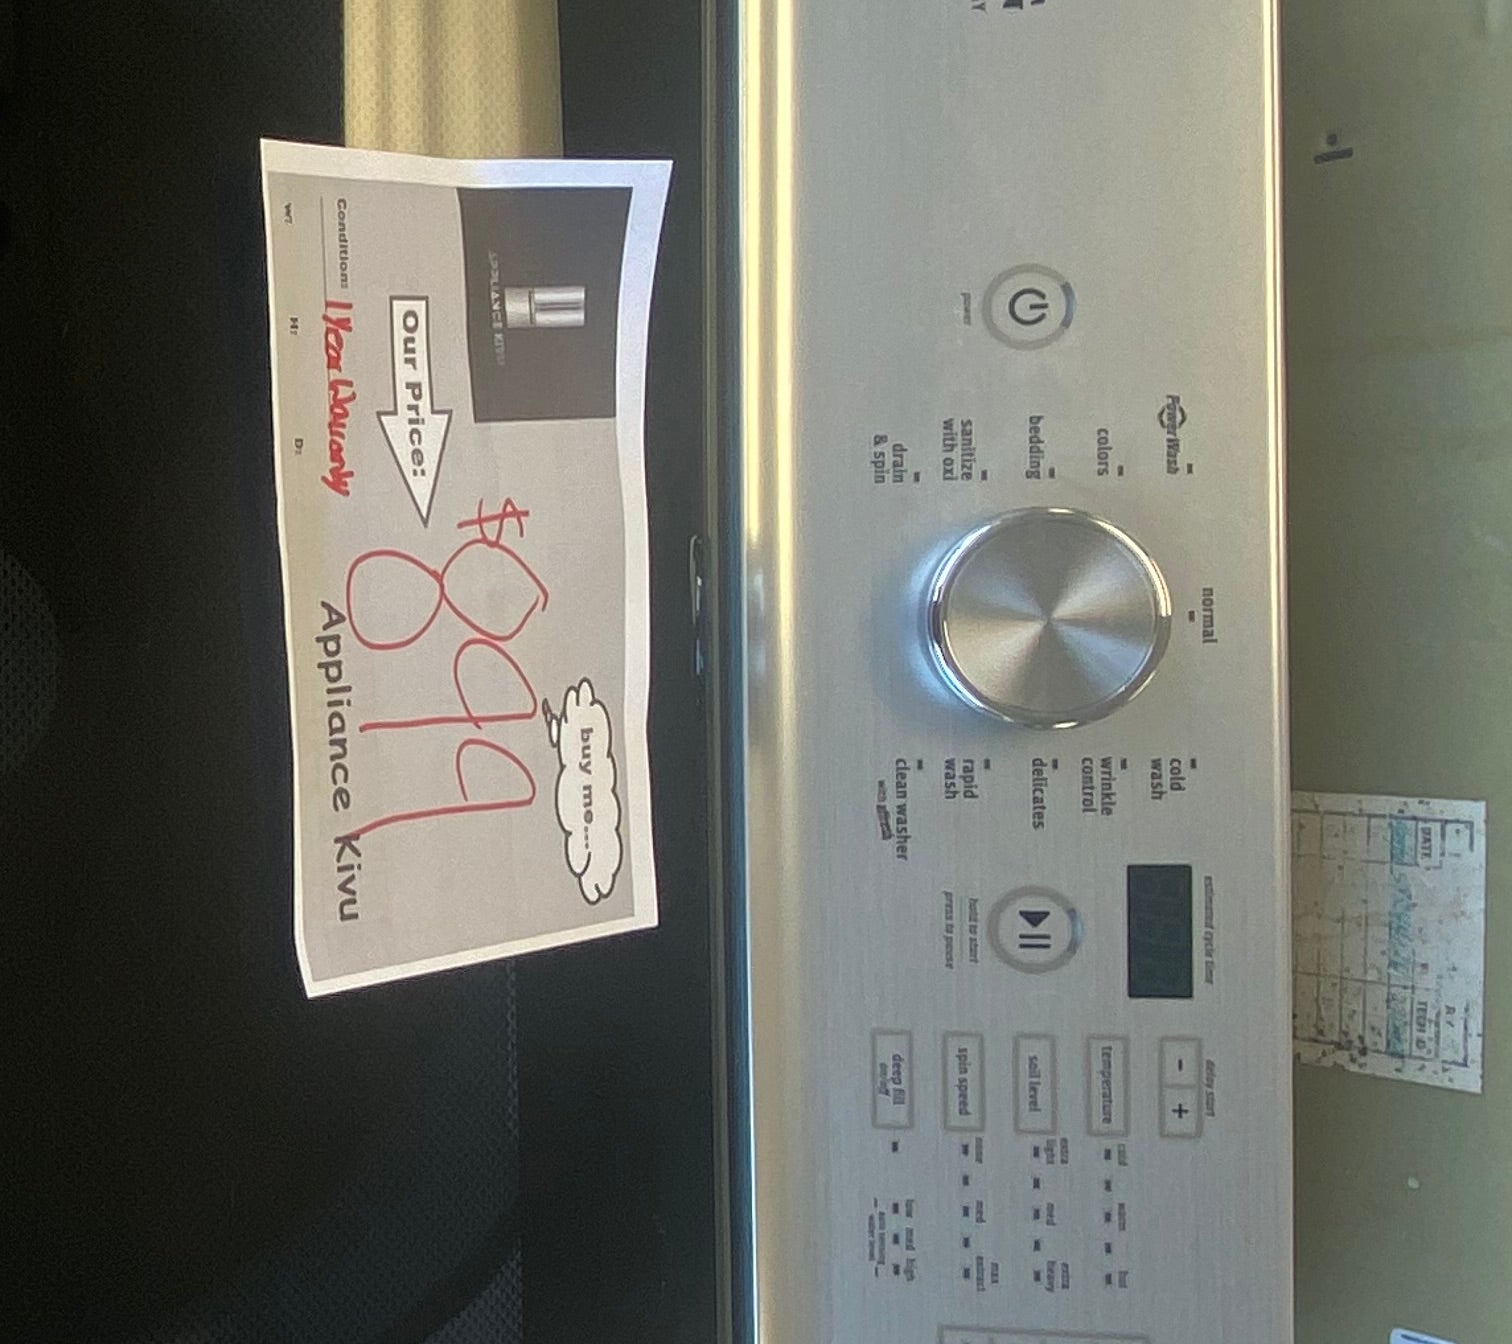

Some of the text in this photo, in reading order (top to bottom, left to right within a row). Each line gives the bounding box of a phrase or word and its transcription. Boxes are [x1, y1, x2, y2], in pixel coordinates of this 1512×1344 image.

[336, 197, 349, 290] Condition:
[961, 292, 972, 326] power
[321, 312, 355, 373] Year
[401, 309, 428, 478] Our Price:
[870, 433, 890, 485] & spin
[891, 442, 909, 484] drain
[941, 417, 958, 482] with oxi
[960, 418, 977, 482] sanitize
[1025, 414, 1045, 480] bedding
[1096, 427, 1112, 477] colors
[1162, 394, 1183, 476] PowerWash
[1201, 587, 1219, 644] normal
[315, 599, 363, 924] Appliance Kivu
[578, 726, 597, 851] buy me...
[944, 757, 960, 801] wash
[960, 758, 979, 800] rapid
[1081, 756, 1097, 814] control
[1100, 756, 1116, 817] wrinkle
[1150, 757, 1167, 801] wash
[1169, 757, 1186, 792] cold
[895, 758, 912, 862] clean washer
[1031, 757, 1048, 831] delicates
[890, 1053, 906, 1106] deep fill
[955, 1047, 972, 1117] spin speed
[1028, 1055, 1042, 1113] soil level
[1098, 1045, 1113, 1125] temperature
